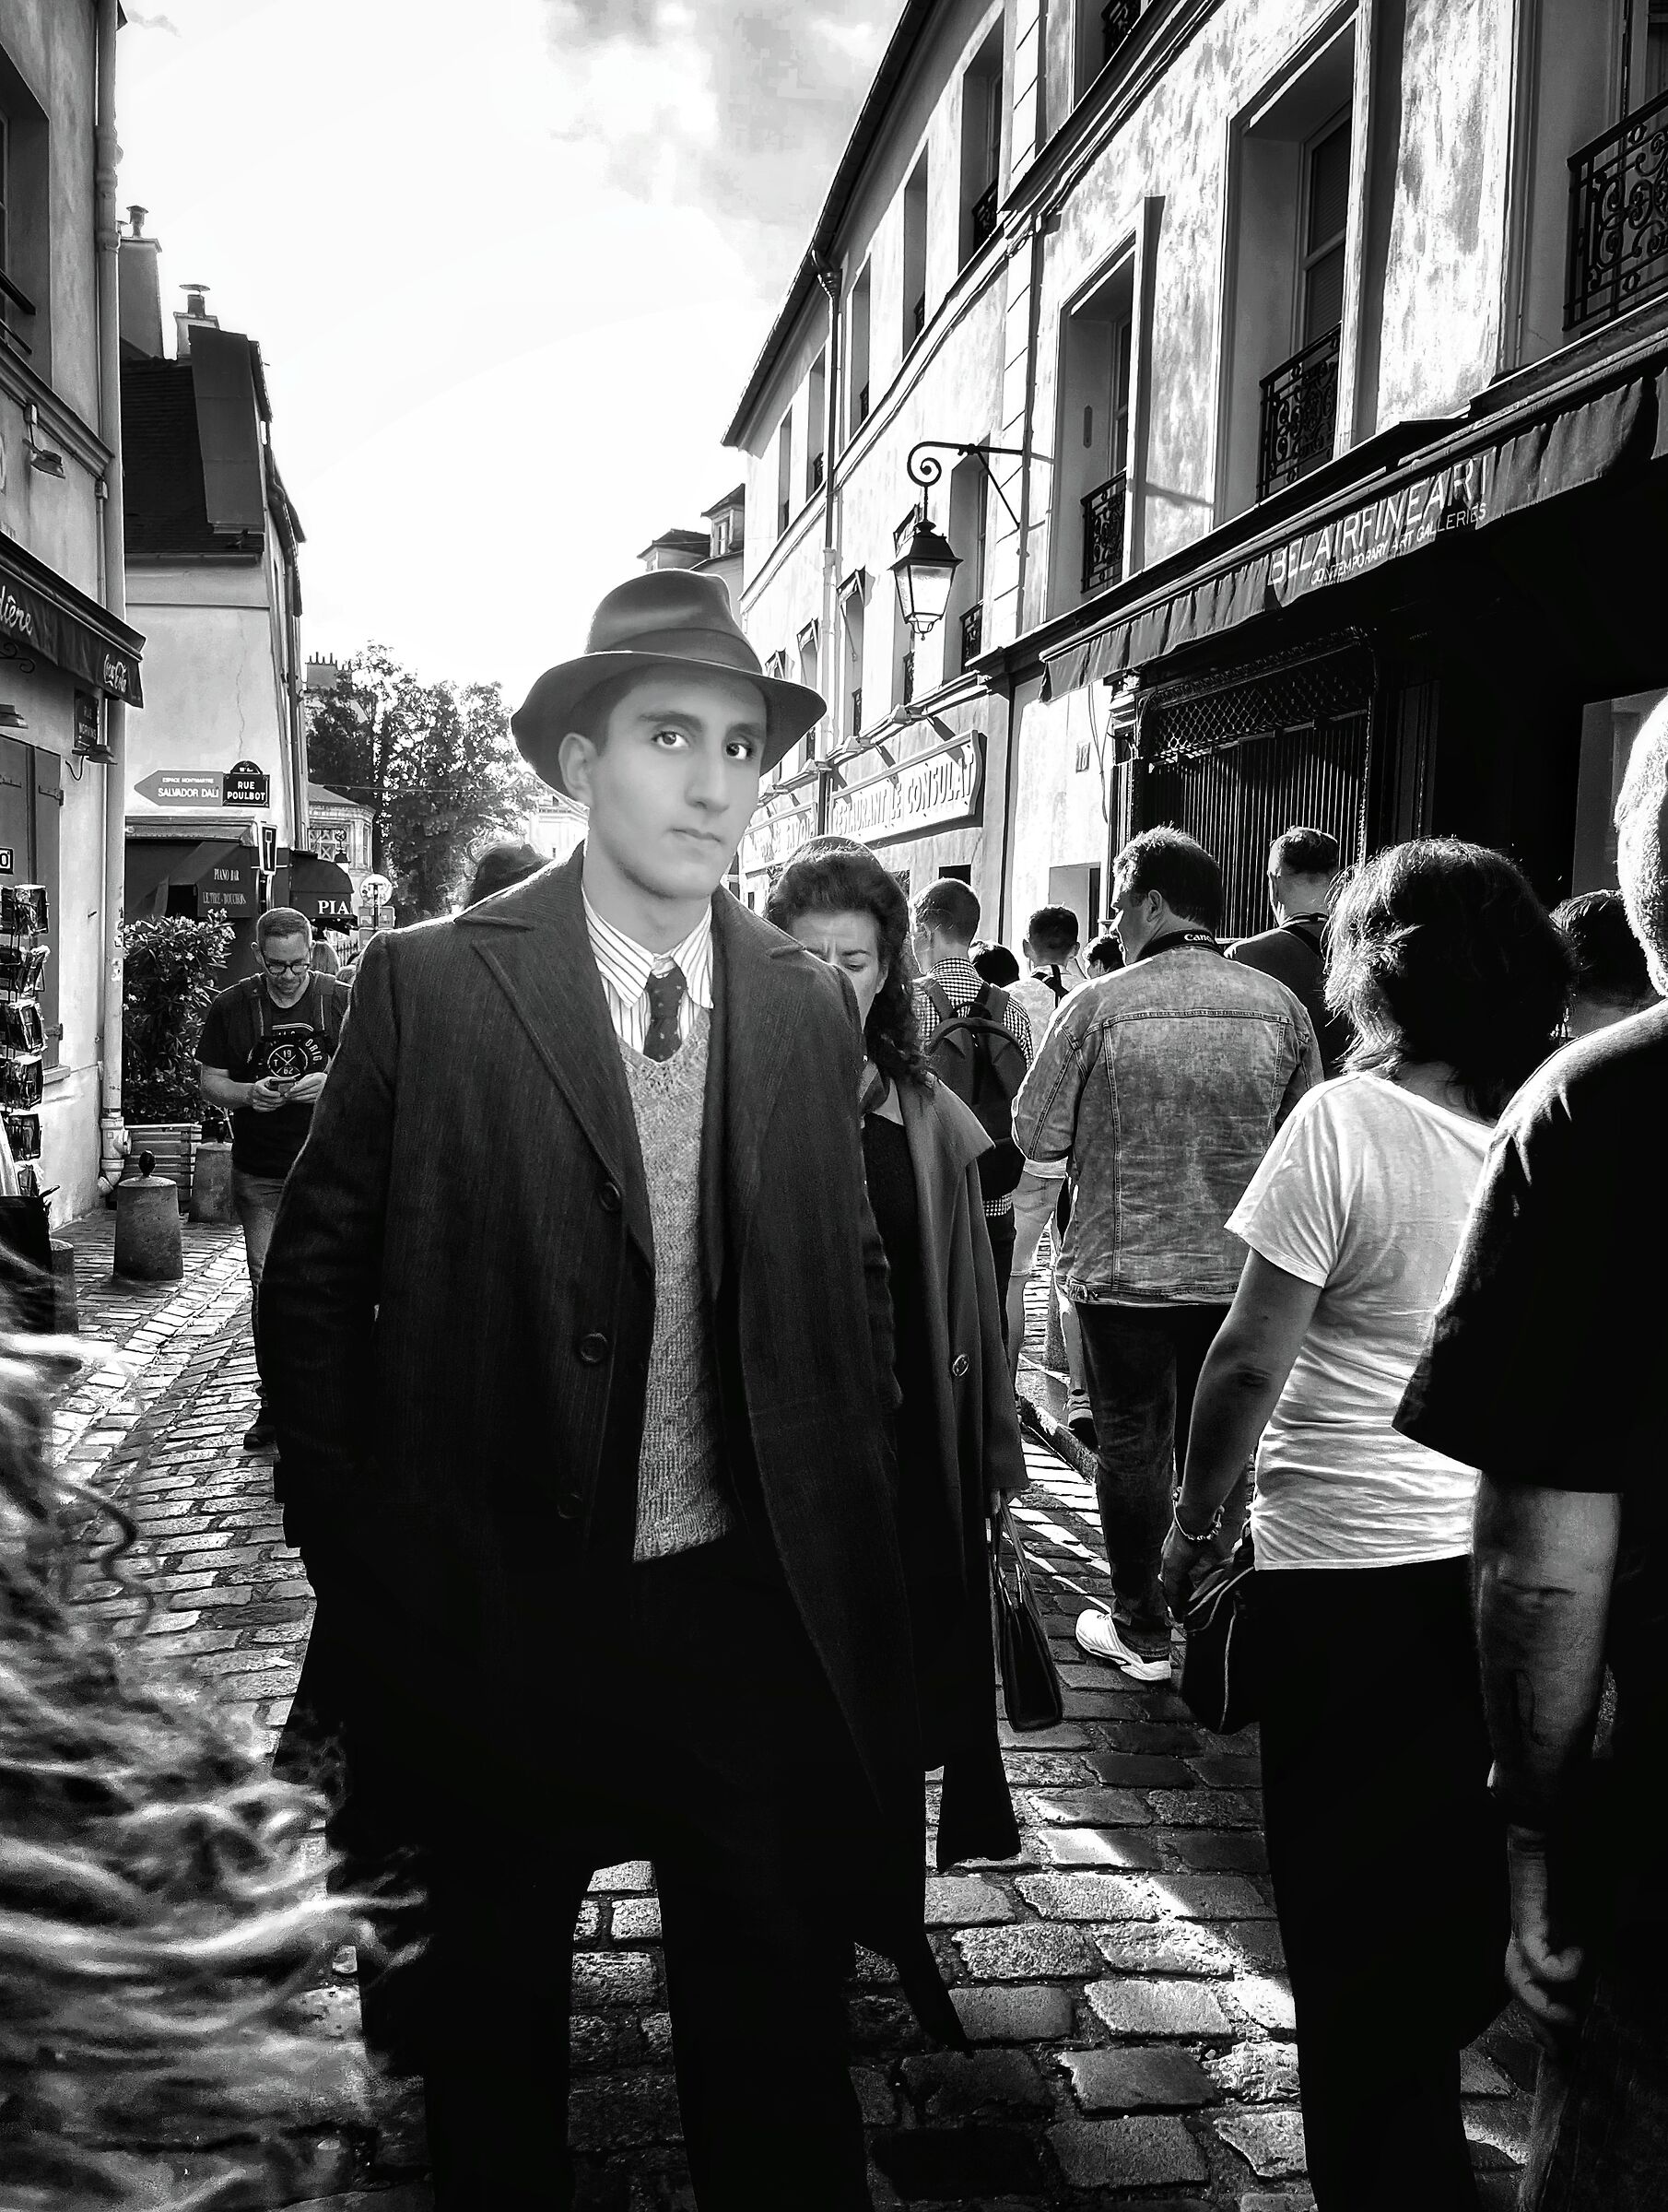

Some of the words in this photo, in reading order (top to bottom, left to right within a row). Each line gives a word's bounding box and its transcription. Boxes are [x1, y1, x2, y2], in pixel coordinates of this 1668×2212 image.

[1311, 542, 1387, 584] CONTEMPORARY
[1392, 530, 1414, 550] ART
[1416, 503, 1486, 543] GALLERIES
[237, 781, 255, 790] RUE
[891, 782, 902, 820] LE
[908, 753, 974, 815] CONSULAT
[158, 787, 199, 798] SALVADOR
[227, 791, 266, 801] POULBOT
[214, 868, 229, 881] PIANO
[318, 900, 352, 915] PIA
